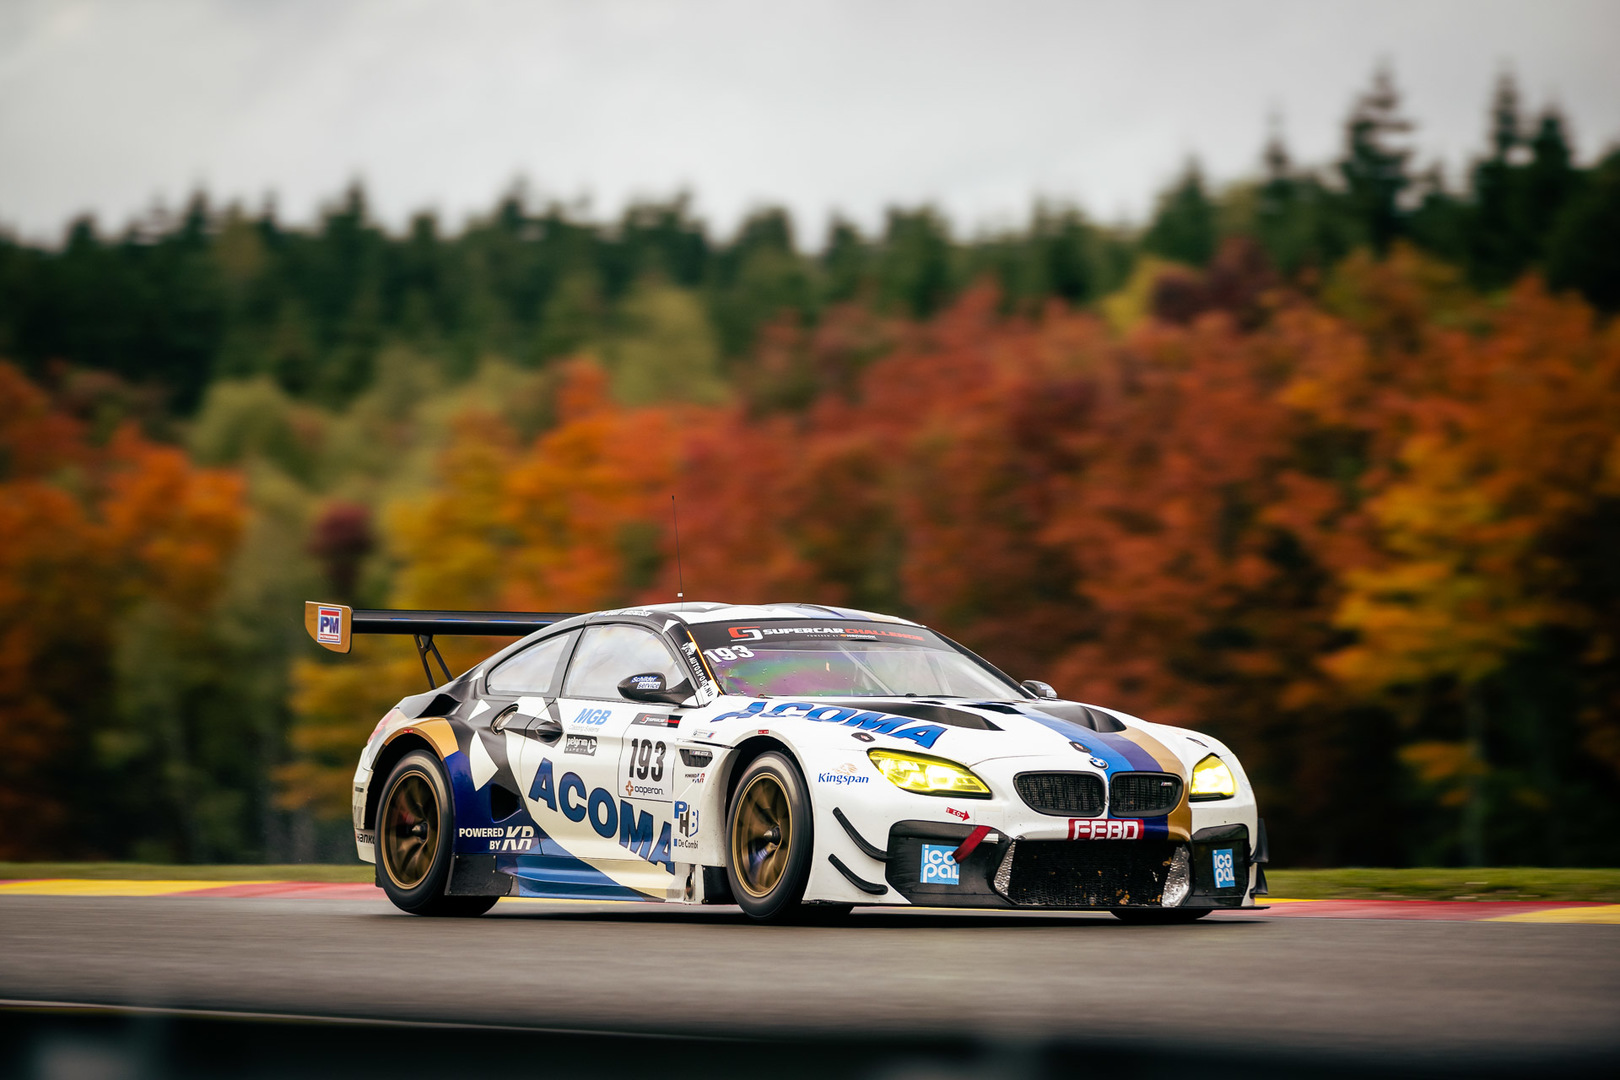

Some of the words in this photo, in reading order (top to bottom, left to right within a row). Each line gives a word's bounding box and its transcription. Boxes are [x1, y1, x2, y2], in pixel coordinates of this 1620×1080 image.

[320, 616, 340, 634] PM
[763, 627, 845, 635] SUPERCAR
[703, 645, 755, 663] 193
[573, 708, 612, 726] MGB
[710, 701, 949, 750] ACOMA
[629, 738, 666, 782] 193
[818, 772, 869, 785] Kingspan
[528, 757, 676, 876] ACOMA
[459, 827, 504, 838] POWERED
[1073, 820, 1139, 840] FEBO
[489, 840, 502, 850] BY
[924, 844, 957, 865] ico
[1213, 849, 1232, 869] ico
[922, 863, 960, 884] pal
[1215, 867, 1235, 888] pal
